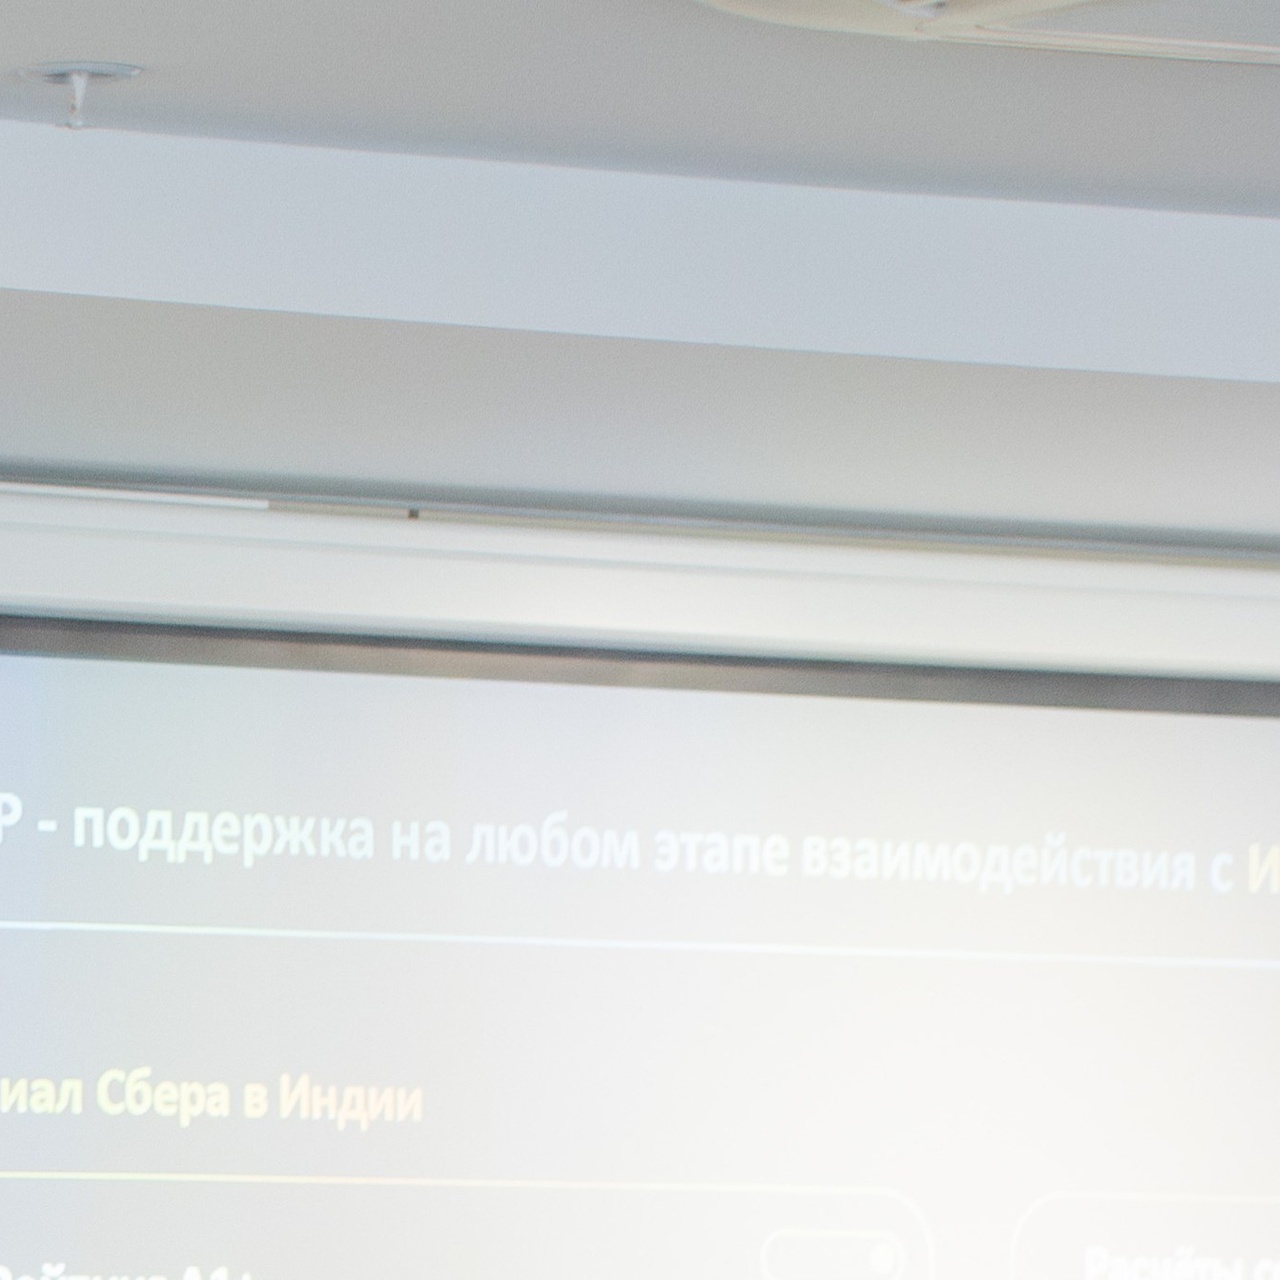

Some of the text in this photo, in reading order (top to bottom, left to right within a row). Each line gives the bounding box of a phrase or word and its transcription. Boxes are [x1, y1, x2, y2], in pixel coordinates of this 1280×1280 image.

[73, 806, 376, 868] поддержка
[391, 817, 450, 863] на
[465, 810, 639, 869] любом
[653, 827, 789, 876] этапе
[801, 831, 1197, 894] взаимодействия
[1210, 852, 1234, 894] с
[96, 1067, 230, 1127] Сбера
[244, 1083, 268, 1118] в
[279, 1073, 424, 1130] Индии
